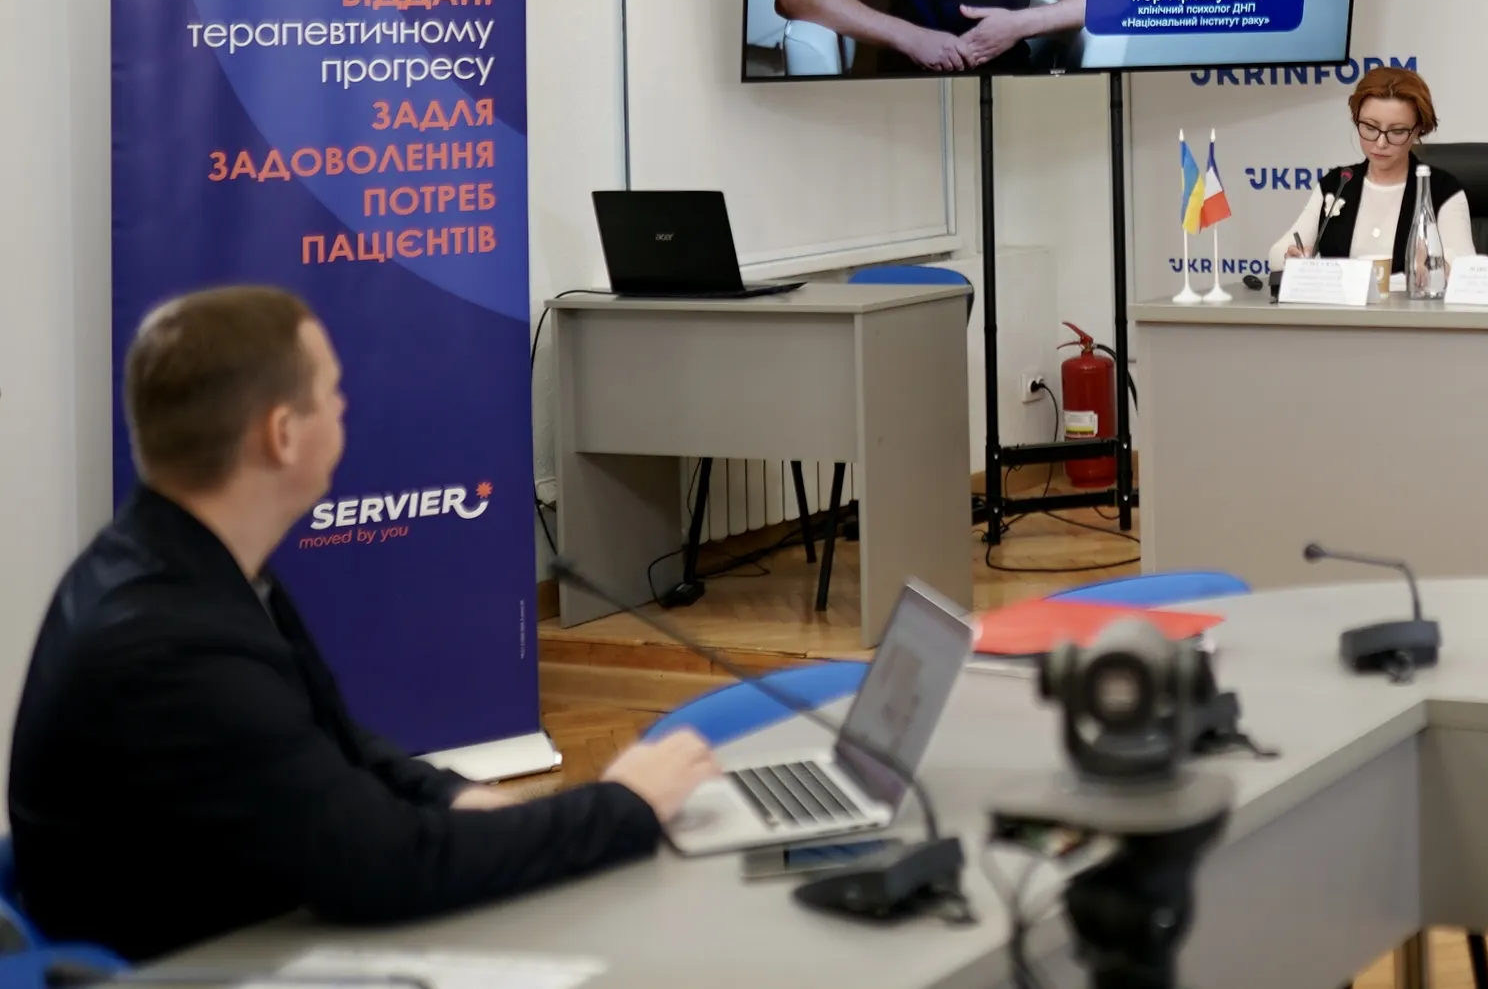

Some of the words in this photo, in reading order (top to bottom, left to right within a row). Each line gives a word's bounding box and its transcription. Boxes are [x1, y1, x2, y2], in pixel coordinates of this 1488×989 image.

[1138, 4, 1184, 15] клінічний
[1186, 3, 1231, 16] психолог
[1232, 3, 1256, 15] ДНП
[1200, 16, 1240, 27] інститут
[187, 19, 495, 54] терапевтичному
[321, 55, 495, 89] прогресу
[371, 98, 494, 131] ЗАДЛЯ
[208, 140, 495, 183] ЗАДОВОЛЕННЯ
[363, 183, 496, 217] ПОТРЕБ
[302, 225, 497, 265] ПАЦІЄНТІВ
[310, 486, 489, 530] SERVIER
[299, 530, 353, 549] moved
[356, 528, 378, 544] by
[380, 524, 409, 542] you
